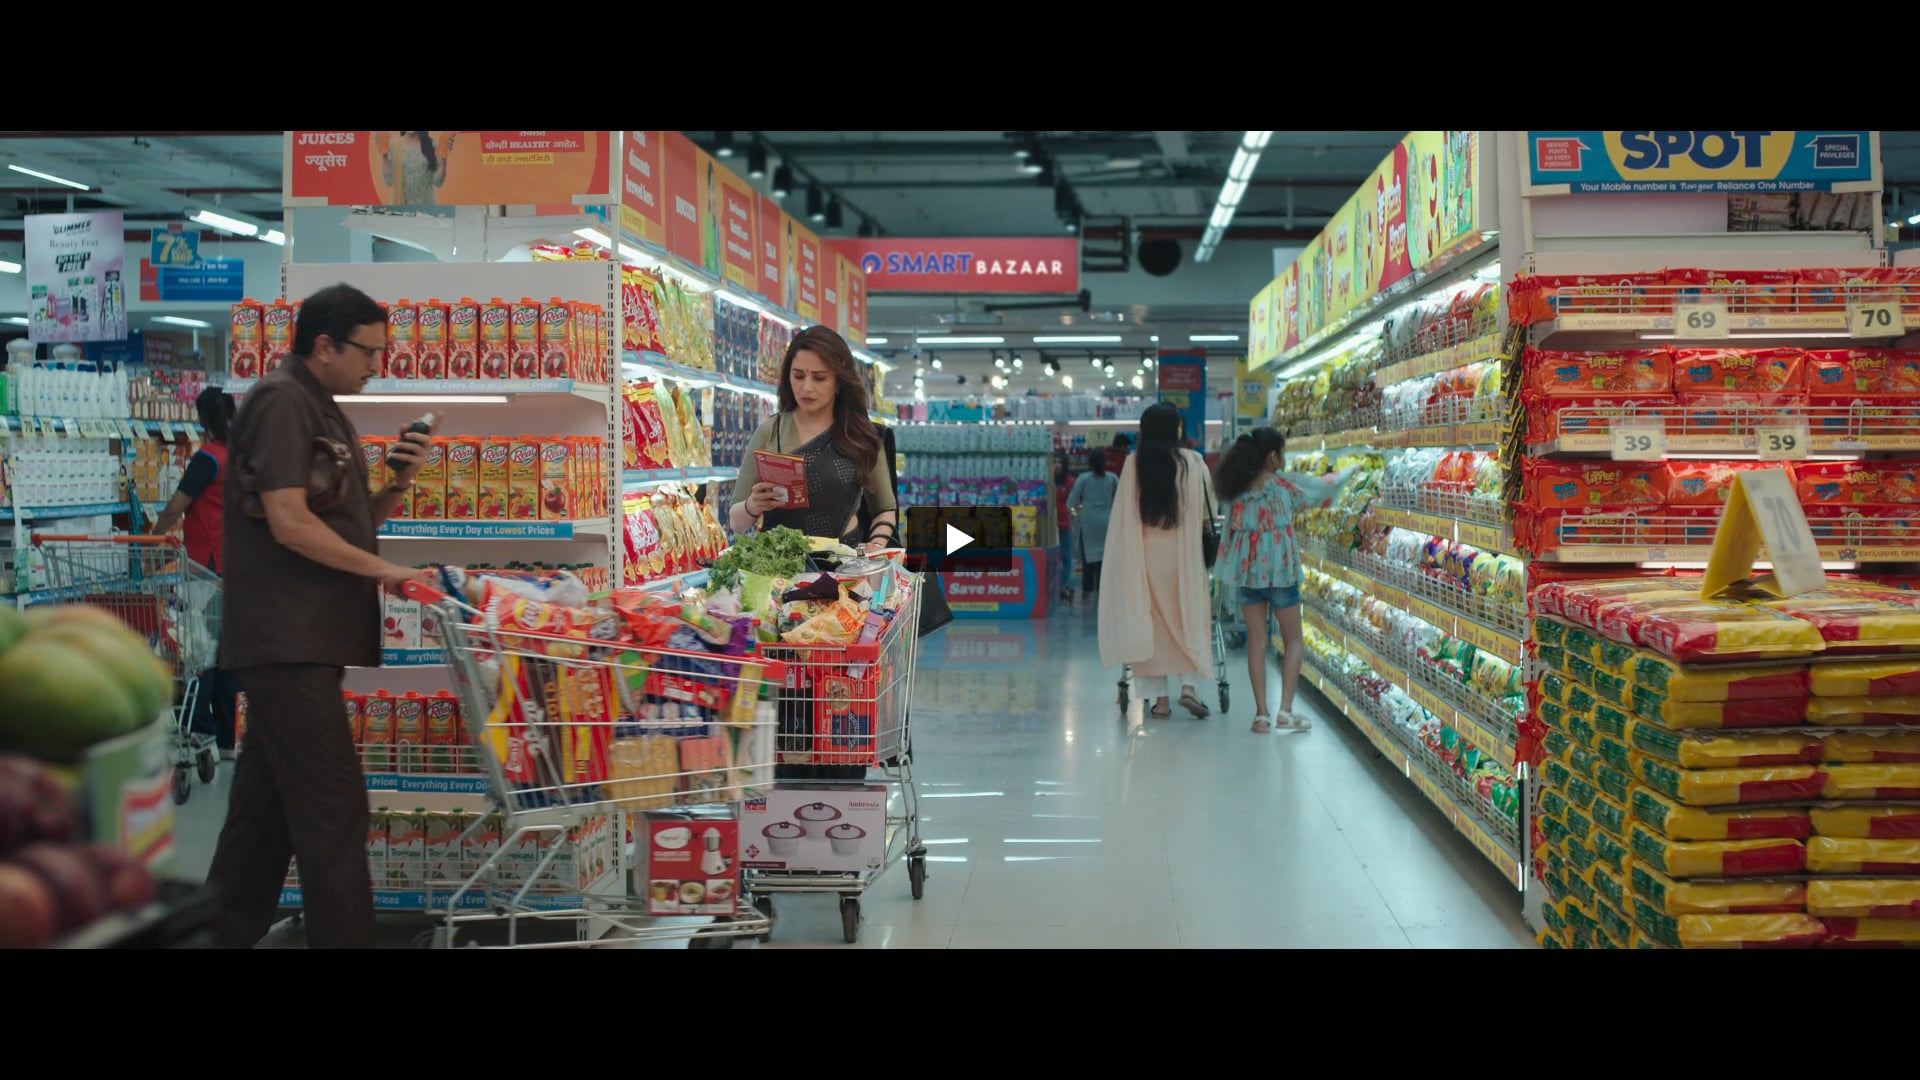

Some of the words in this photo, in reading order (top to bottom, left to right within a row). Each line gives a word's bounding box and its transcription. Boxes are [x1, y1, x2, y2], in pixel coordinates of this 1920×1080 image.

[298, 132, 355, 145] JUICES
[510, 140, 551, 149] HEALTHY
[1619, 131, 1772, 171] SPOT
[1820, 151, 1856, 159] PRIVILEGES
[1544, 160, 1572, 168] PURCHASE
[1580, 183, 1600, 191] Your
[1601, 183, 1632, 191] Mobile
[1717, 181, 1756, 190] Reliance
[1757, 181, 1777, 190] One
[1778, 181, 1815, 189] Number
[886, 252, 973, 275] SMART
[976, 260, 1063, 275] BAZAAR
[1687, 312, 1716, 329] 69
[1861, 309, 1892, 328] 70
[1623, 435, 1652, 451] 39
[1768, 434, 1796, 451] 39
[392, 524, 438, 537] Everything
[439, 525, 463, 537] Every
[464, 525, 483, 537] Day
[484, 526, 493, 536] at
[495, 526, 526, 536] Lowest
[527, 526, 555, 537] Prices
[953, 566, 984, 579] Buy
[987, 566, 1020, 577] More
[949, 582, 986, 595] Save
[988, 585, 1020, 595] More
[388, 603, 418, 614] Tropicana
[372, 777, 398, 787] Prices
[402, 778, 449, 791] Everything
[450, 780, 475, 792] Every
[475, 780, 488, 791] Da
[848, 800, 880, 808] Ambrosia
[373, 894, 400, 905] Prices
